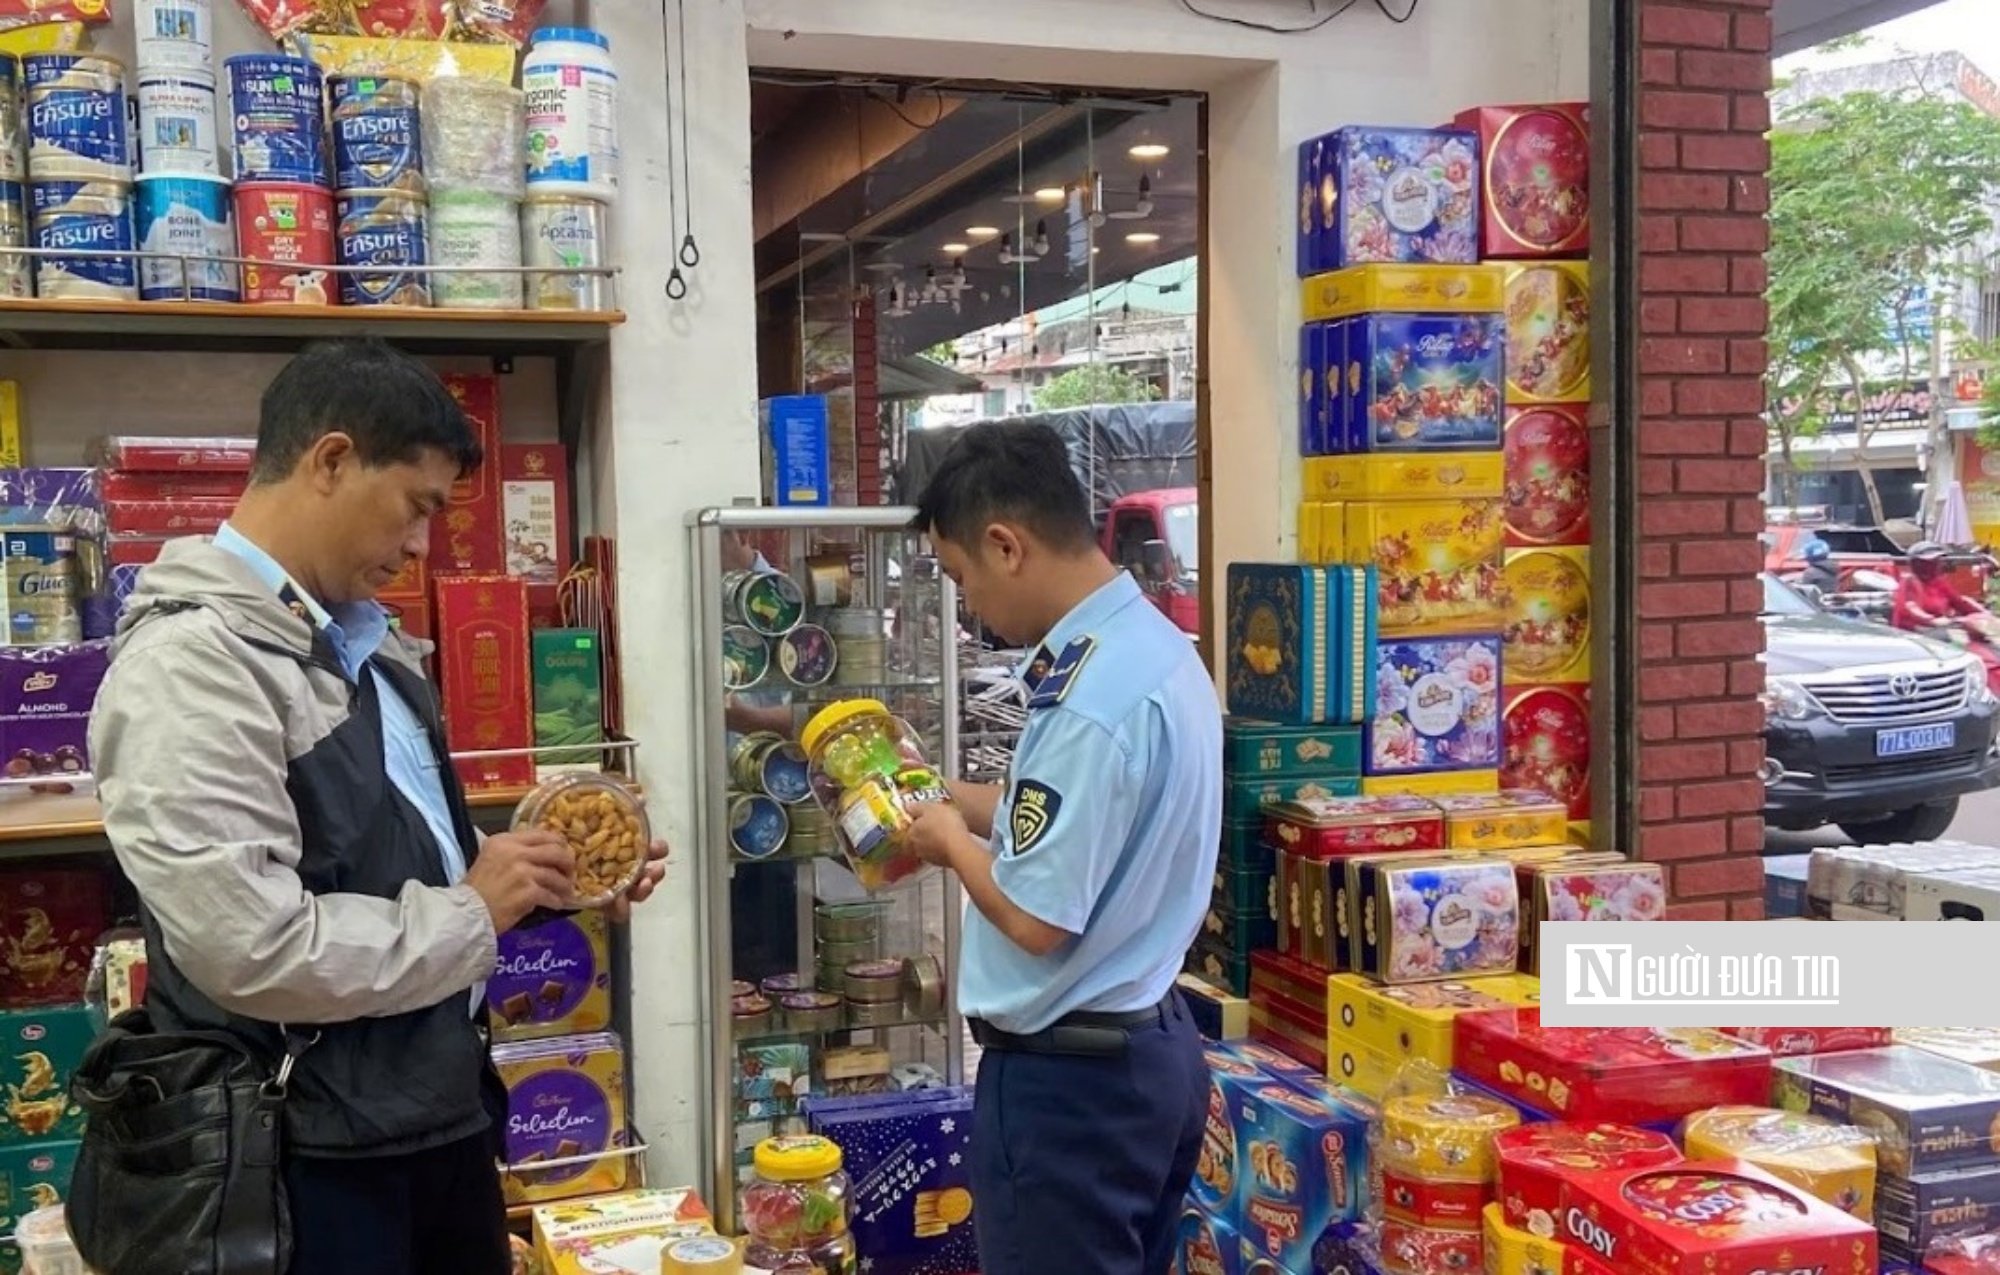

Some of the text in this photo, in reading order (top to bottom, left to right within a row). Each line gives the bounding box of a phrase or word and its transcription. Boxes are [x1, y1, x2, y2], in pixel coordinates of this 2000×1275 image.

[32, 97, 110, 127] Ensure
[342, 114, 410, 141] Ensure
[40, 222, 115, 251] Ensure
[343, 230, 409, 257] Ensure
[18, 703, 68, 714] ALMOND
[495, 949, 579, 976] Selection
[508, 1106, 595, 1134] Selection
[1566, 1207, 1617, 1259] COSY
